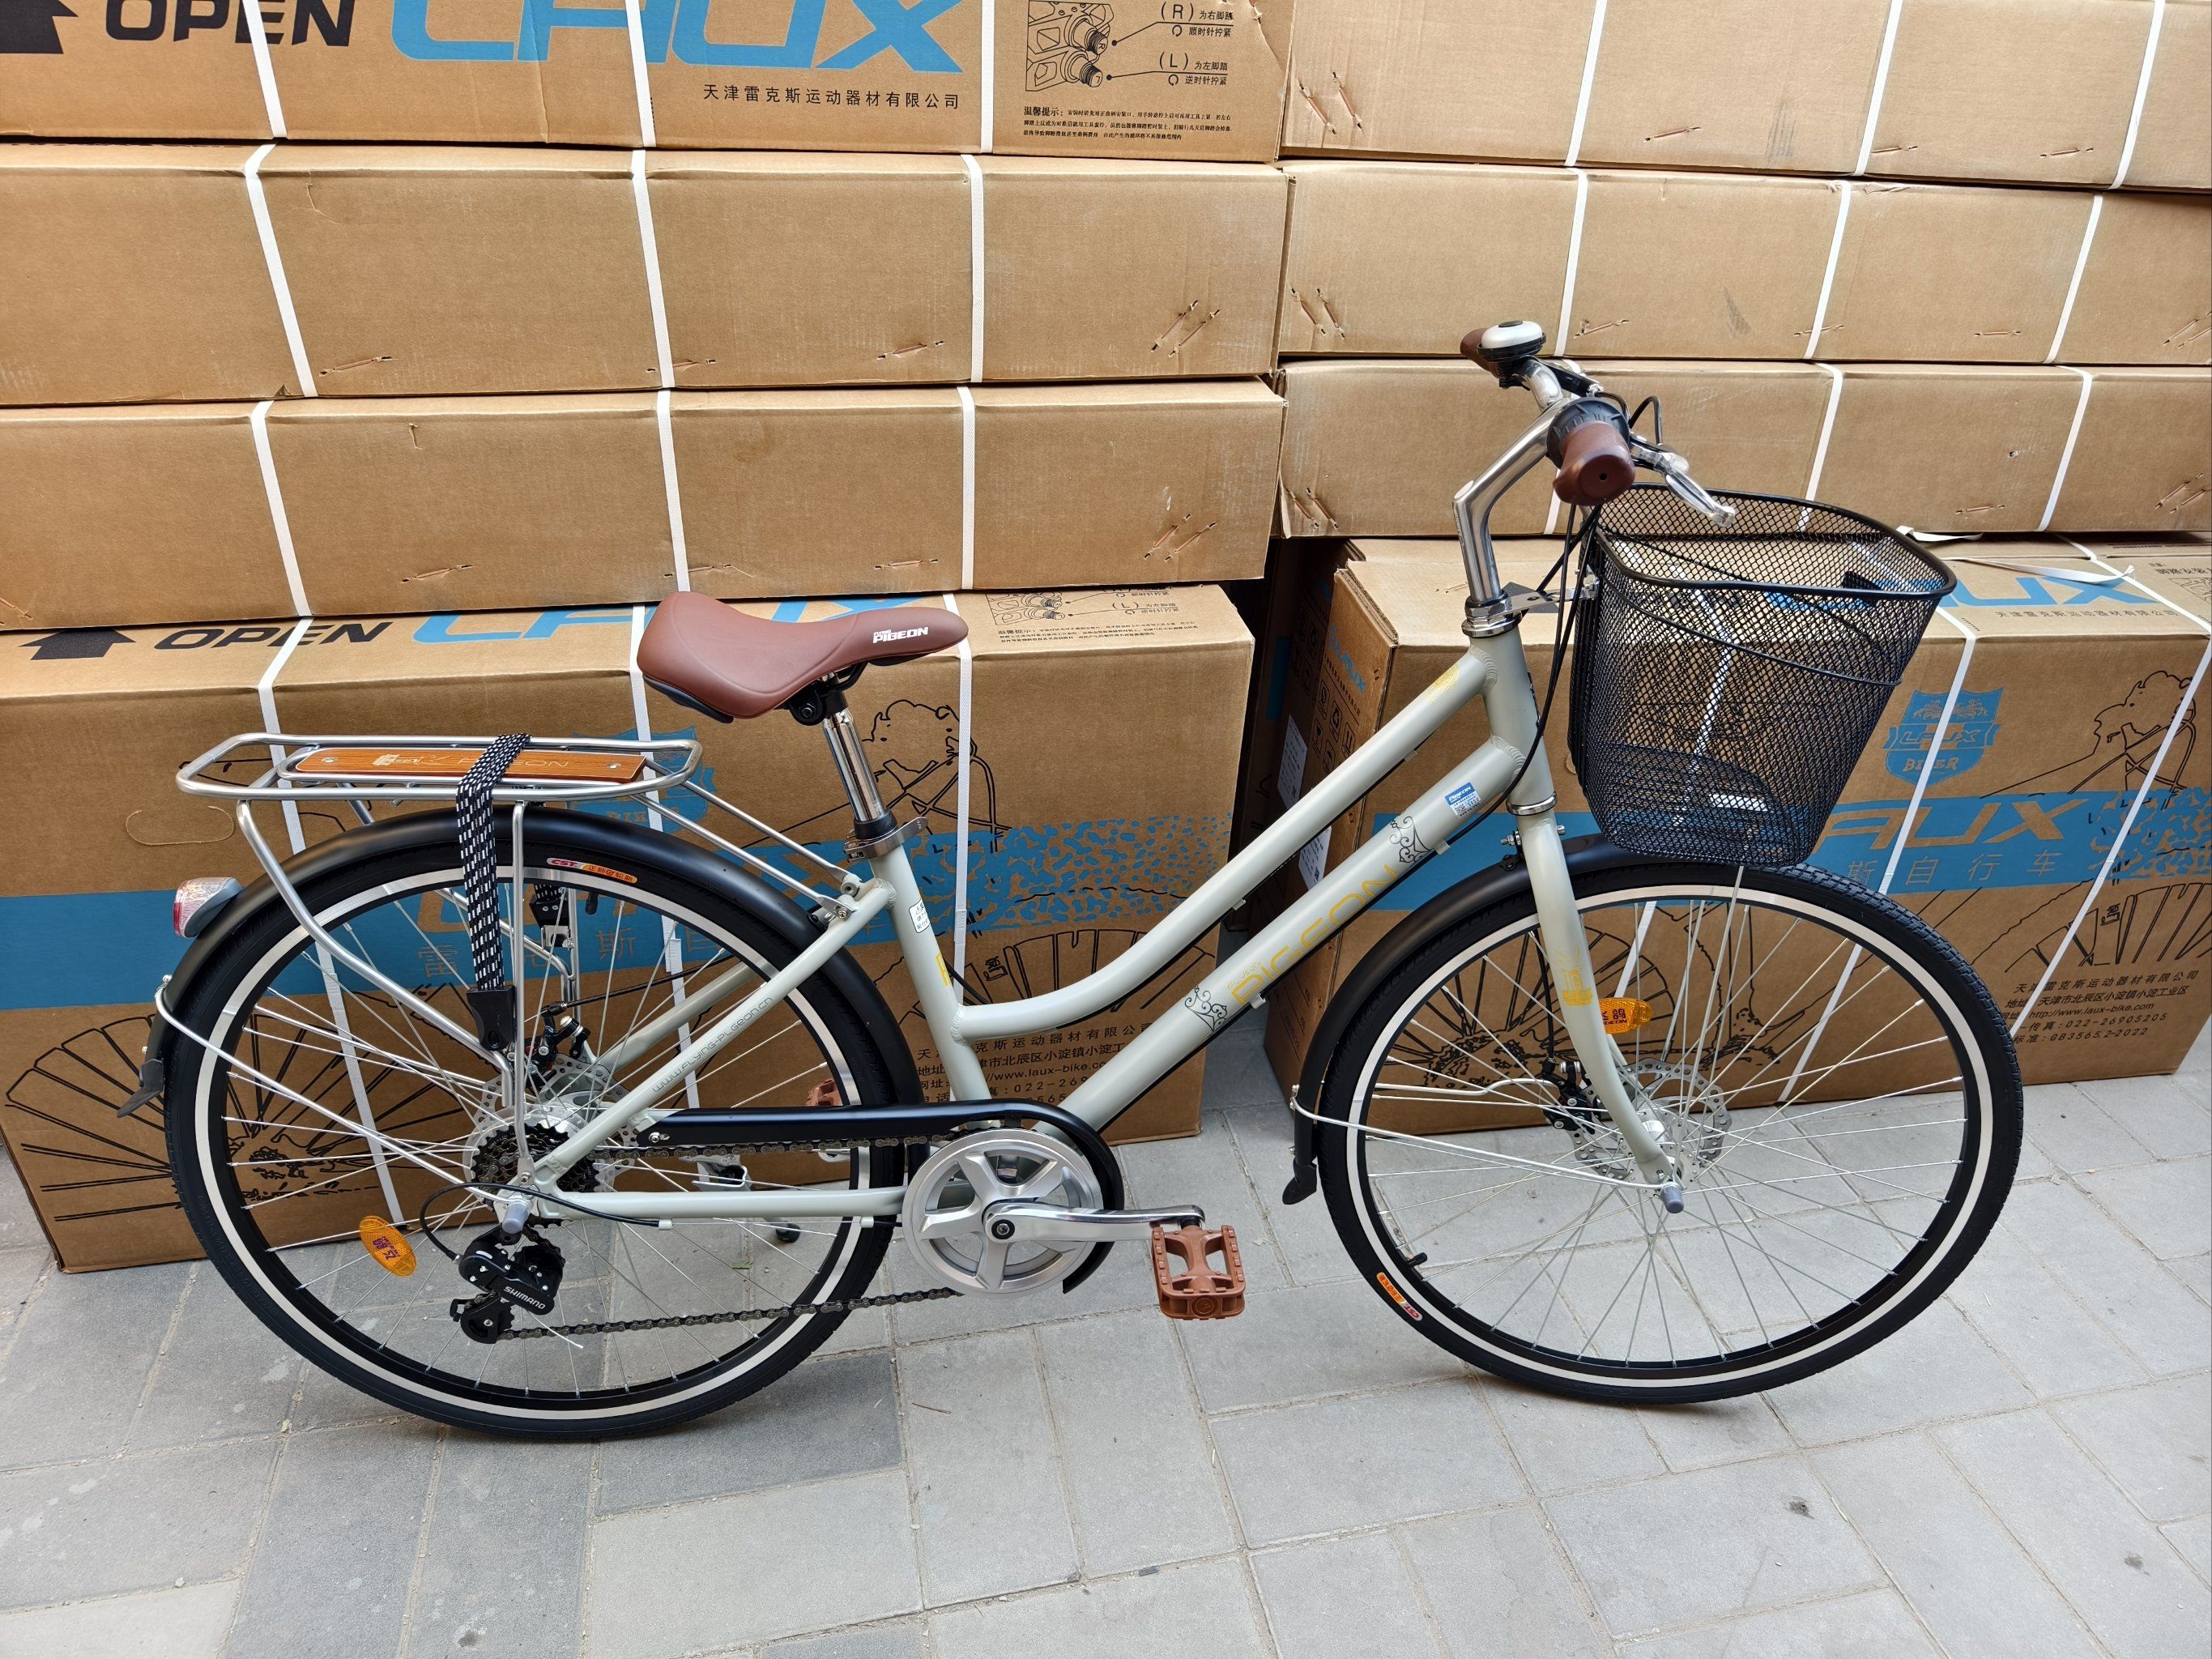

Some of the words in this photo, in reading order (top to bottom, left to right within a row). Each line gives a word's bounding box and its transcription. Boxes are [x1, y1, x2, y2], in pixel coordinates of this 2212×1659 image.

[703, 84, 960, 109] 天津雷克斯运动器材有限公司
[153, 621, 394, 650] OPEN
[873, 627, 929, 643] PIGEON
[1903, 757, 1959, 771] BIER
[1814, 798, 2088, 850] AUX
[503, 1286, 546, 1310] SHIMANO
